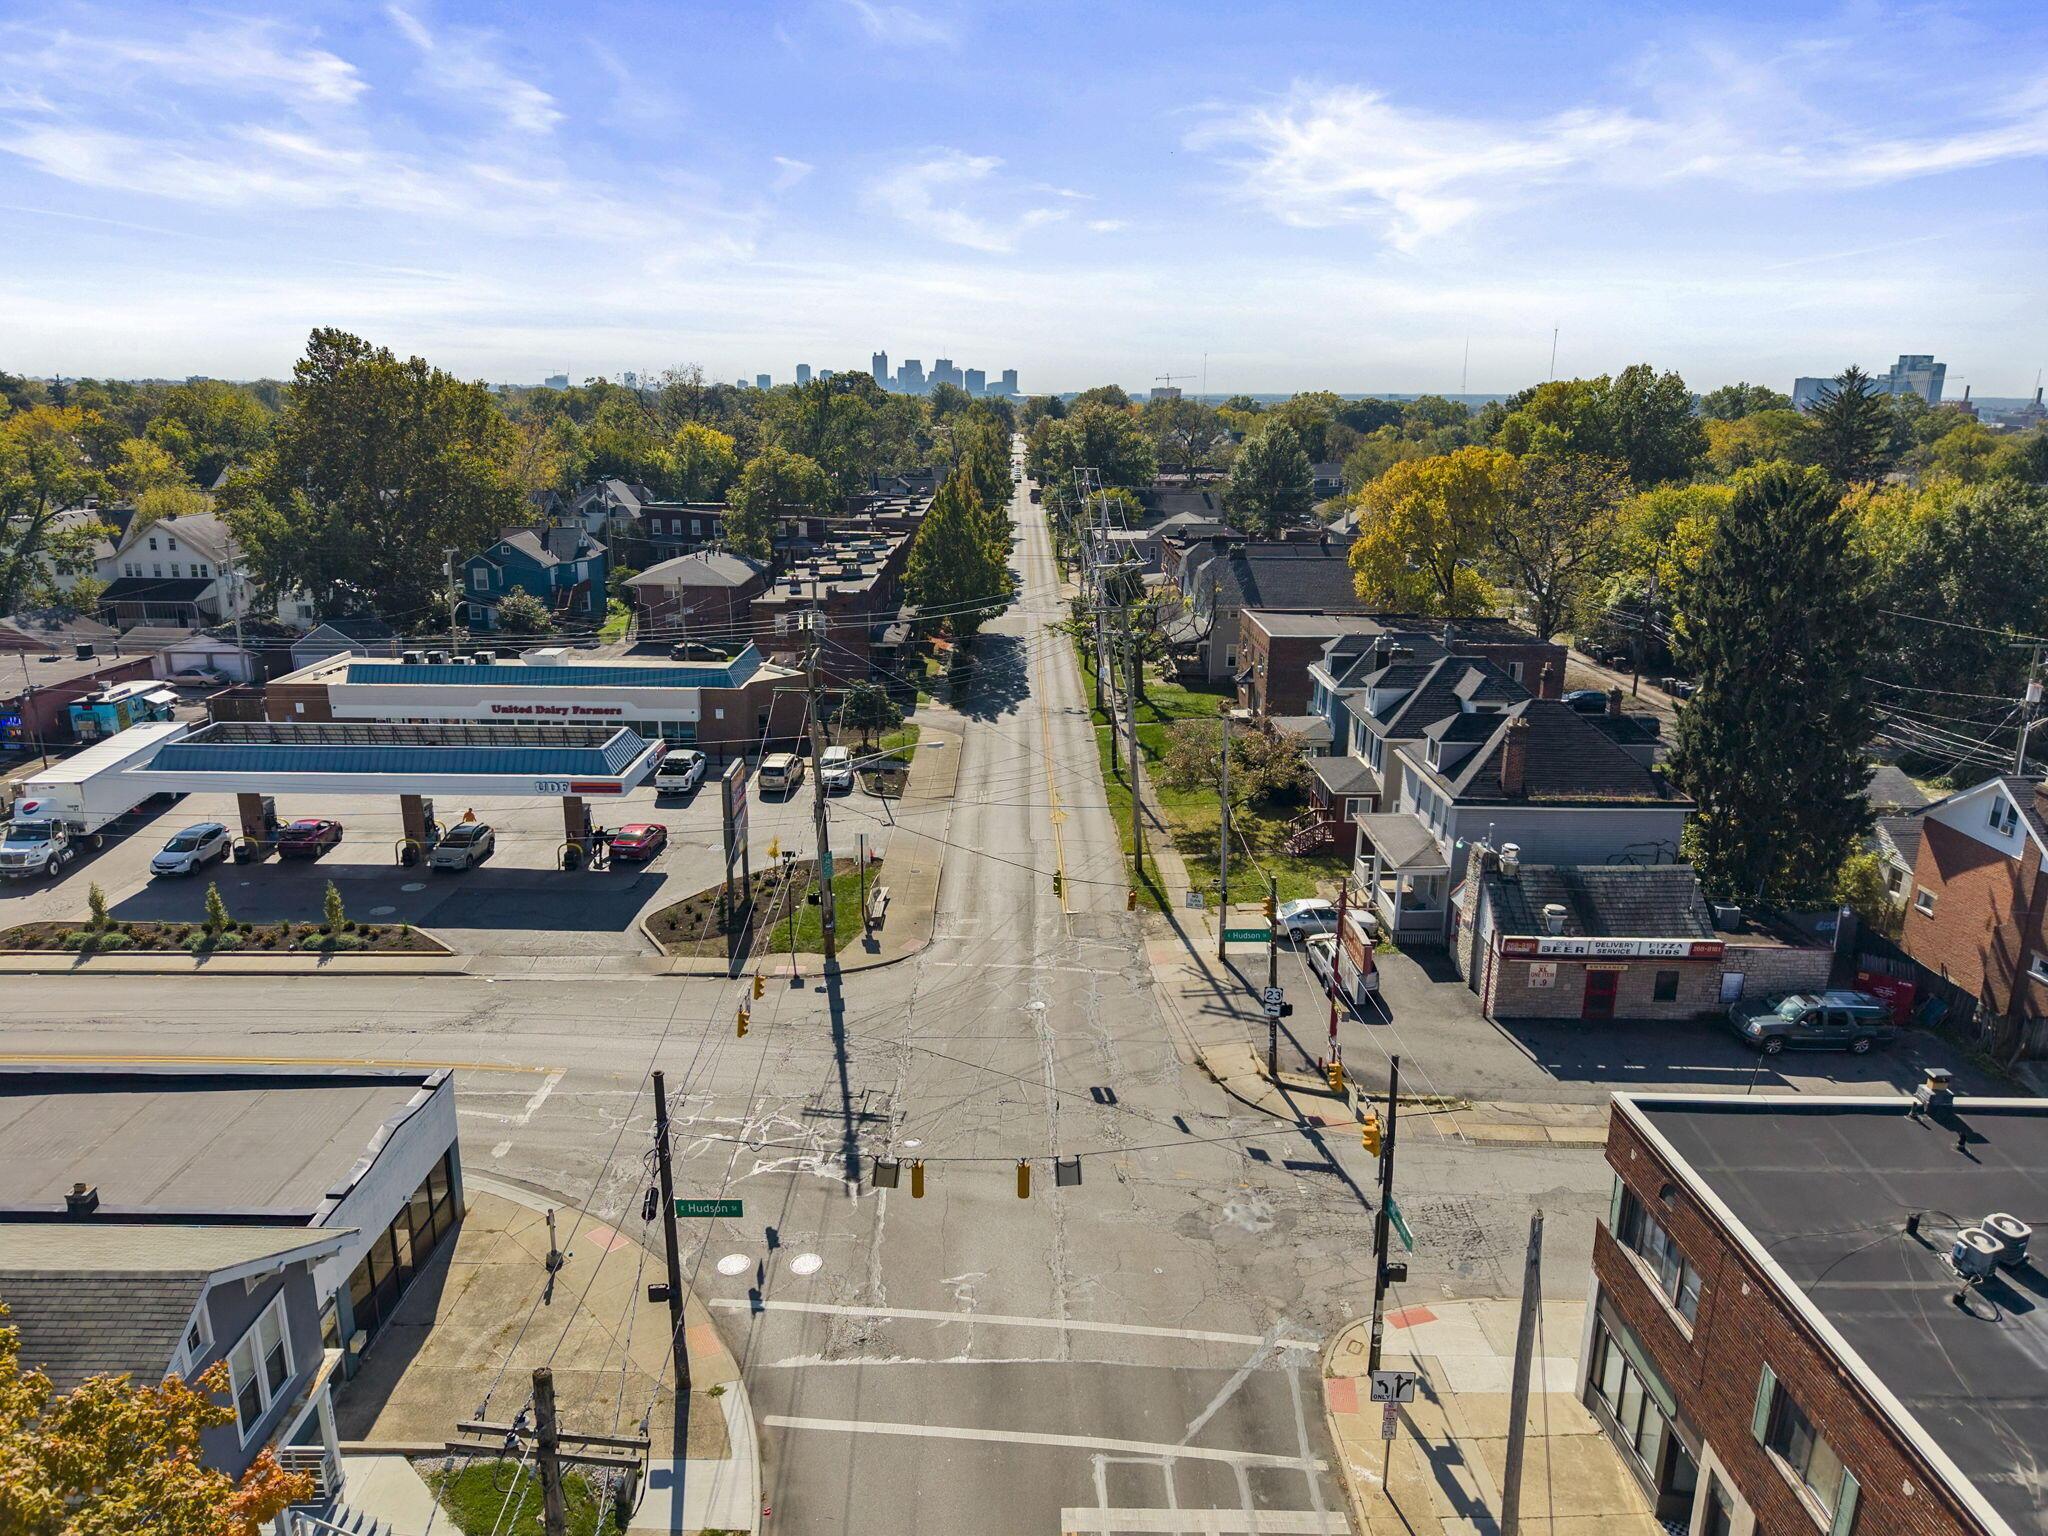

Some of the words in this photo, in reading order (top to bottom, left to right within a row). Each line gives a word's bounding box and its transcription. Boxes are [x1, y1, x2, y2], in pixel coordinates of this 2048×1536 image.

[491, 705, 532, 714] United
[535, 705, 569, 716] Dairy
[572, 706, 622, 715] Farmers
[535, 781, 569, 793] UDF
[1541, 945, 1584, 953] BEER
[1595, 941, 1635, 949] DELIVERY
[1266, 990, 1281, 1001] 23
[688, 1203, 728, 1213] Hudson
